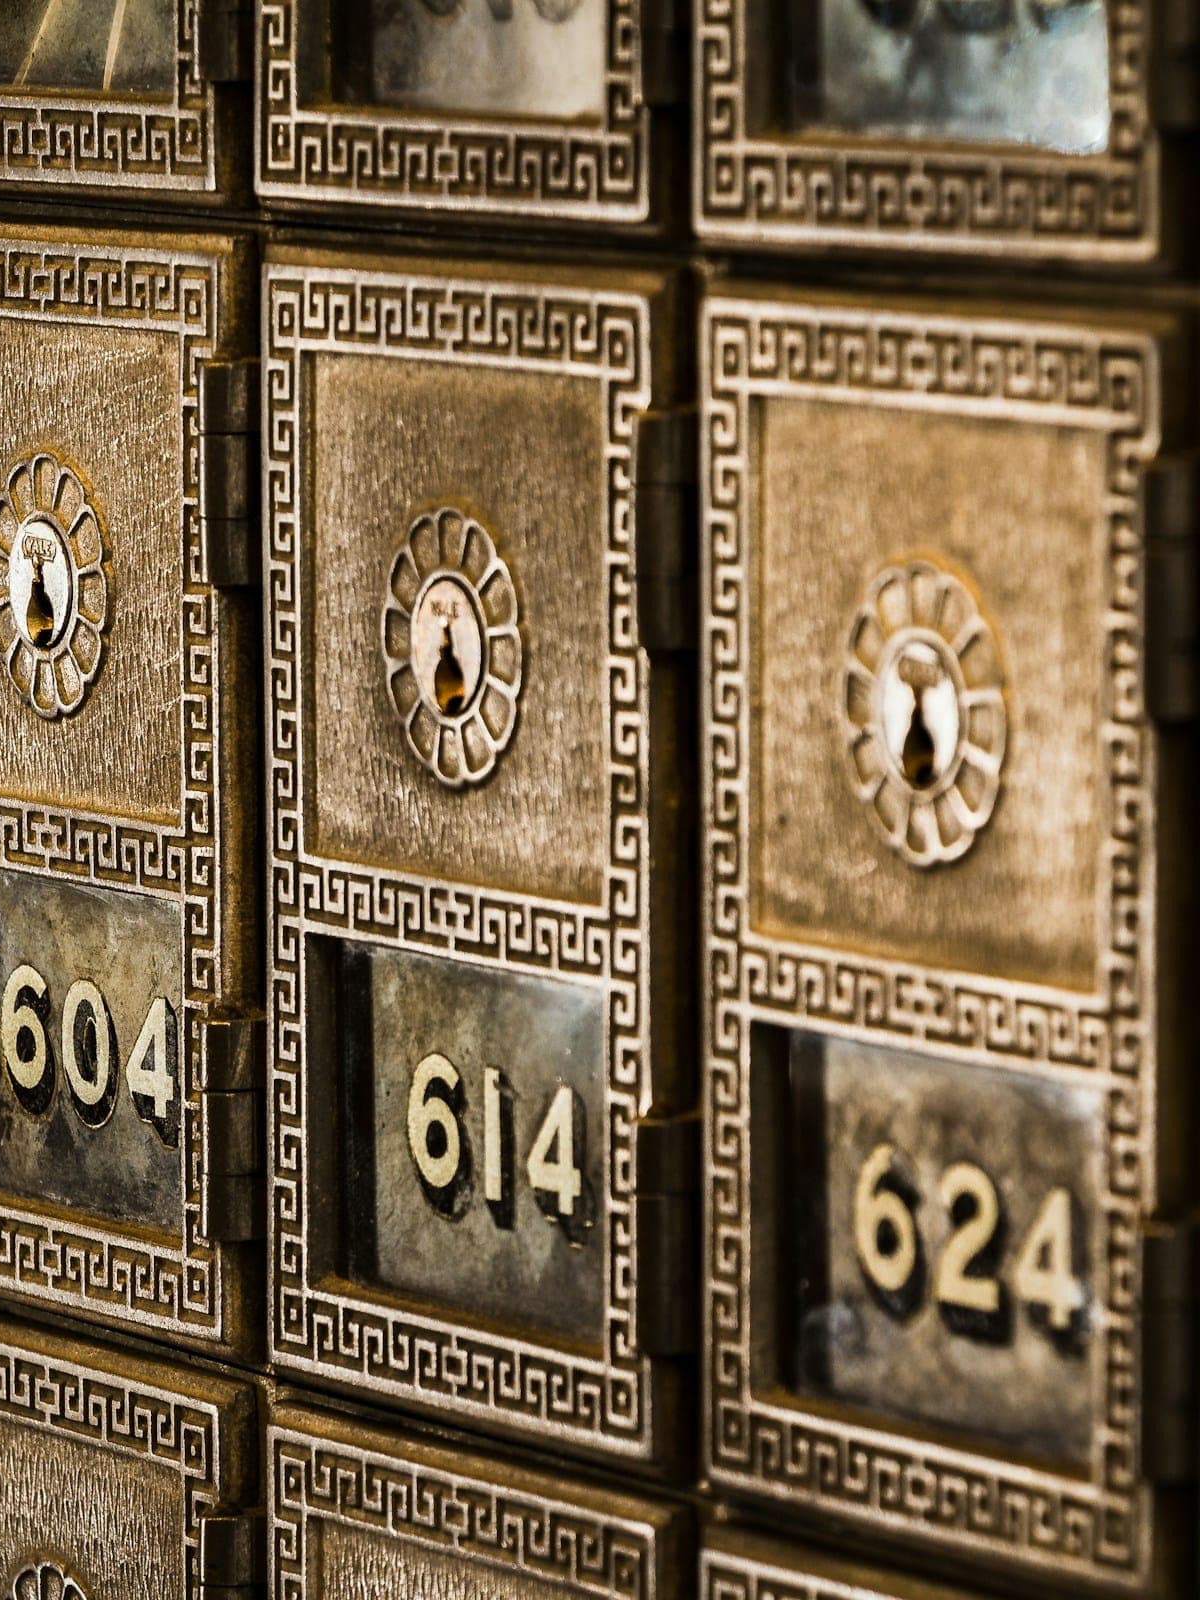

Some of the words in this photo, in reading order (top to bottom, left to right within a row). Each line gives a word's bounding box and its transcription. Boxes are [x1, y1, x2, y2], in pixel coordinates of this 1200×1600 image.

[1, 964, 174, 1119] 604
[407, 1053, 581, 1215] 614
[855, 1142, 1083, 1329] 624
